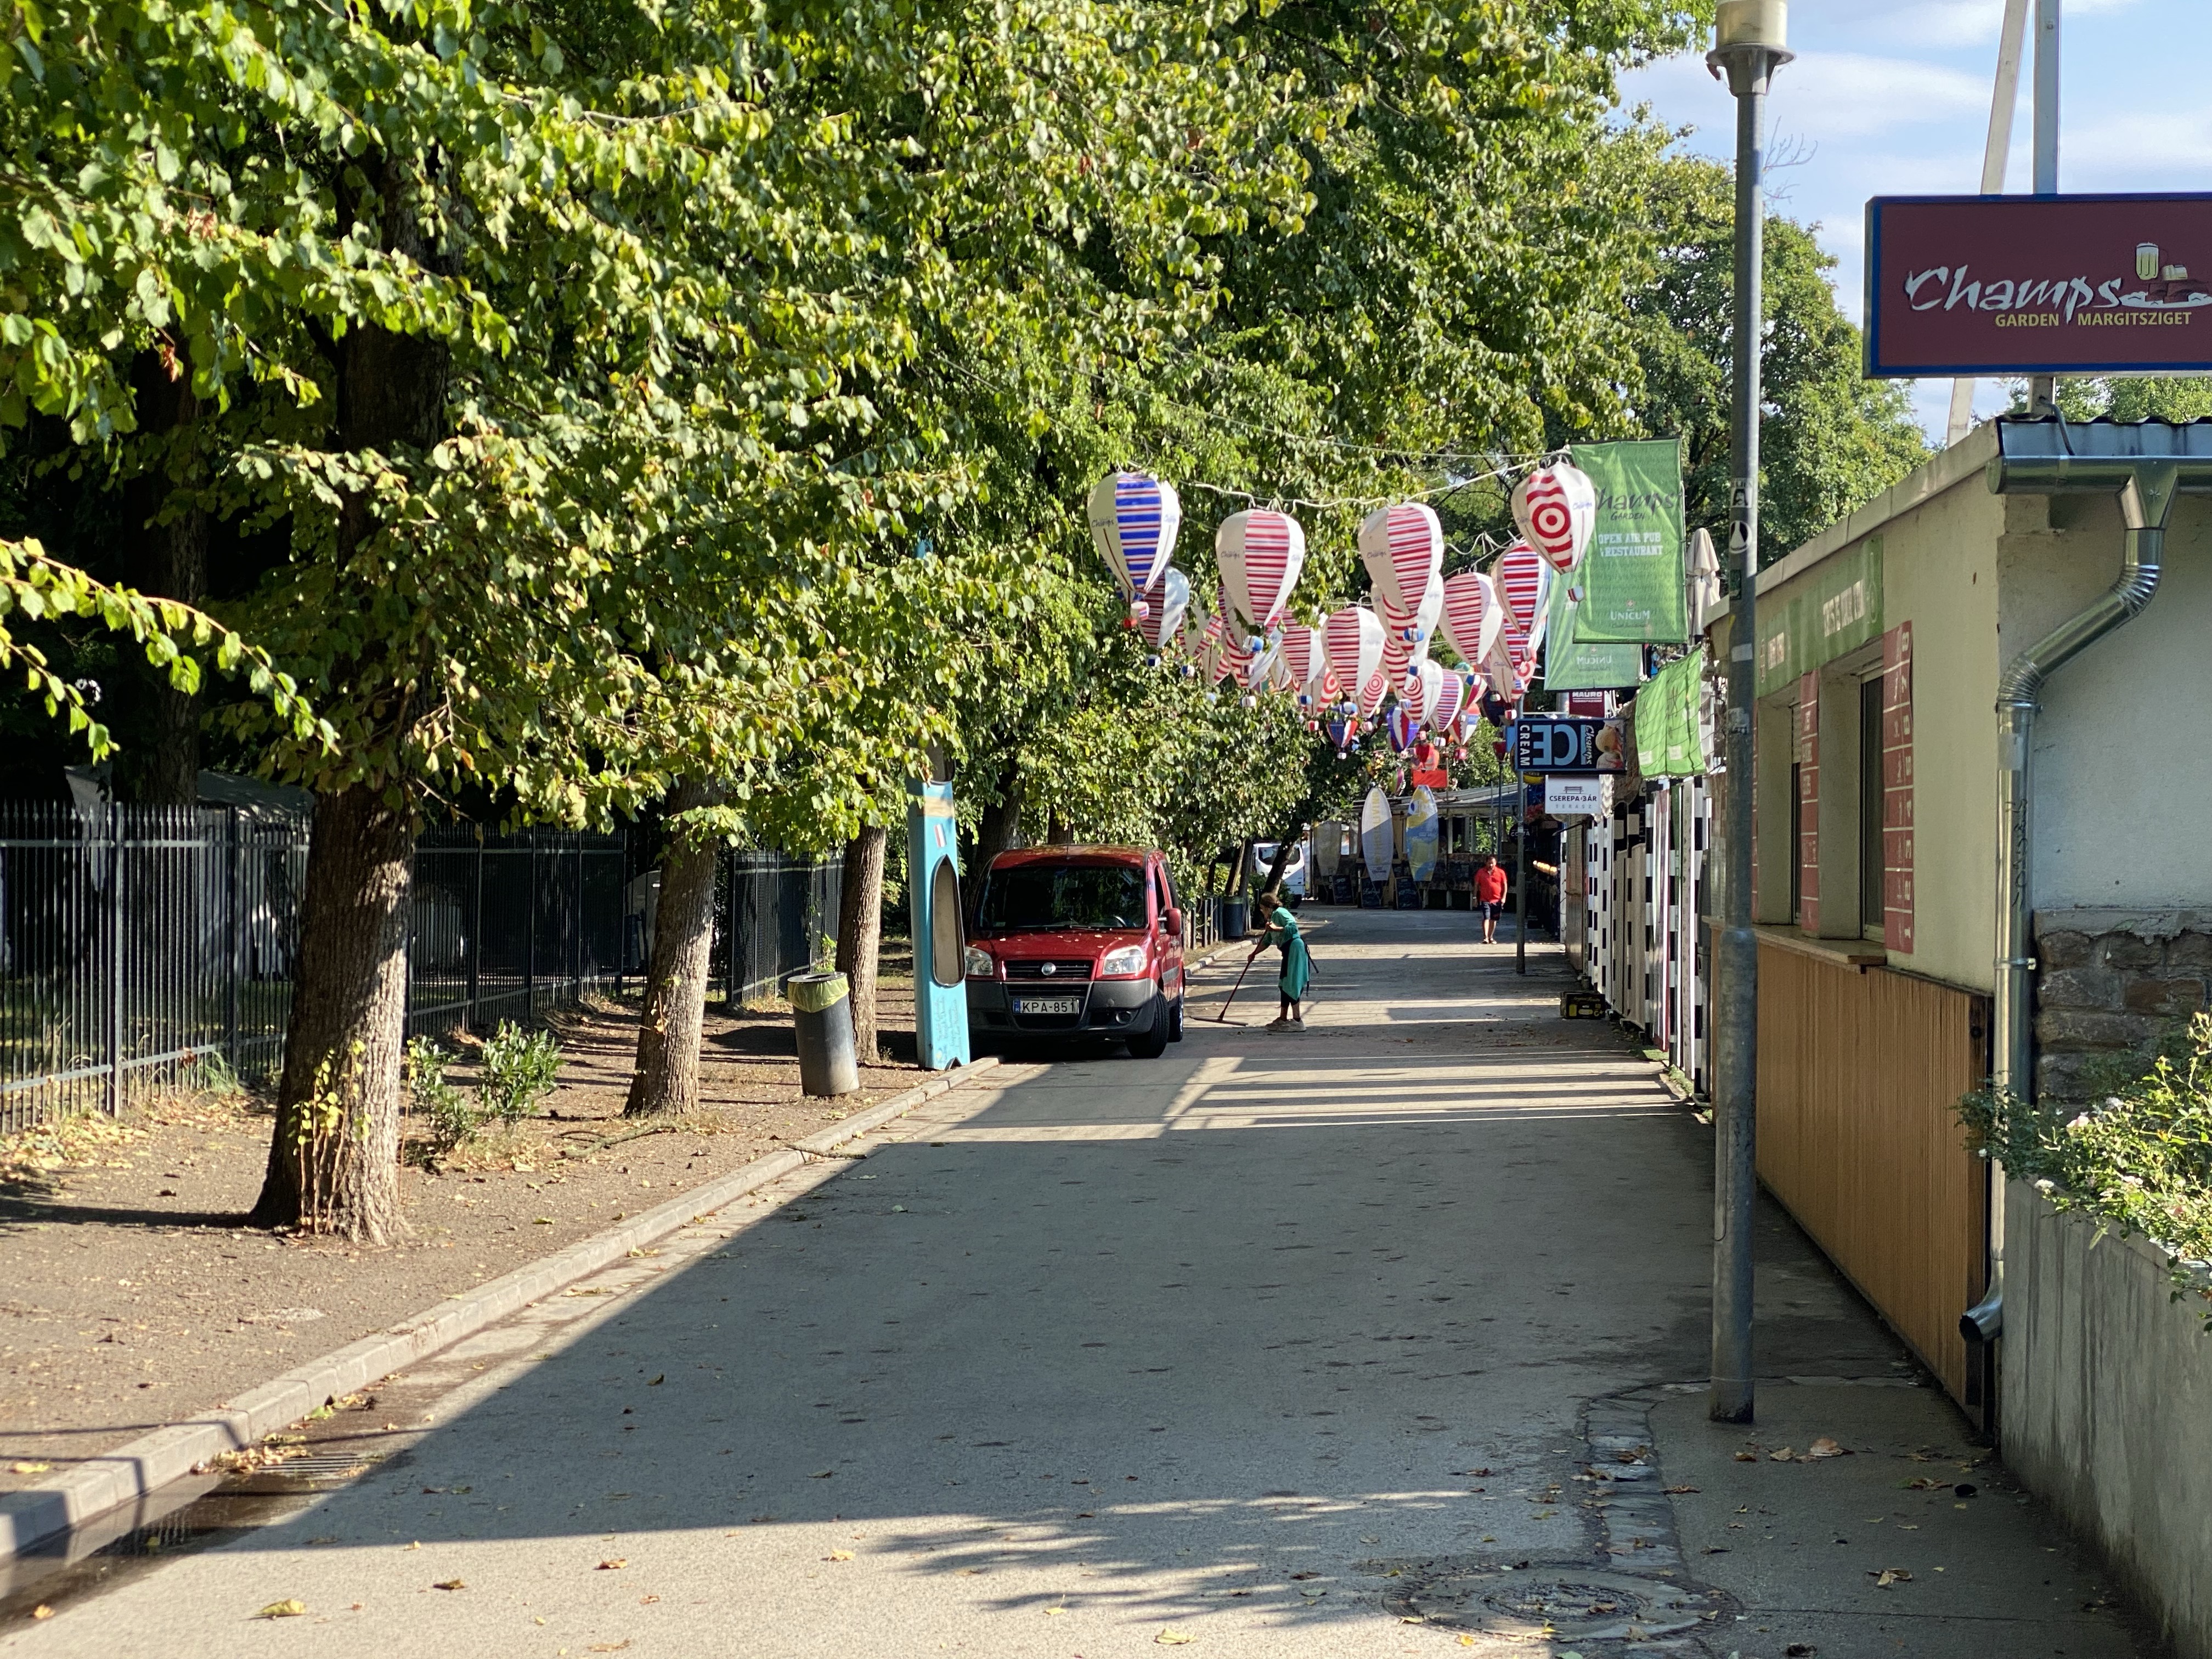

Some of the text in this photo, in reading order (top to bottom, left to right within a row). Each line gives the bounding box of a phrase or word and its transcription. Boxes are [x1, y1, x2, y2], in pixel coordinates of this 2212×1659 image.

[1905, 264, 2122, 325] Champs
[1995, 312, 2192, 327] GARDEN MARGITSZIGET
[1594, 487, 1674, 516] hamps
[1611, 511, 1645, 521] GARDEN
[1598, 532, 1661, 544] OPEN AIR PUB
[1605, 545, 1663, 557] RESTAURANT
[1610, 610, 1650, 620] UNICUM
[1520, 725, 1530, 766] CREAM
[1532, 724, 1587, 766] ICE
[1583, 725, 1595, 765] Champs
[1022, 1002, 1074, 1013] KPA-851
